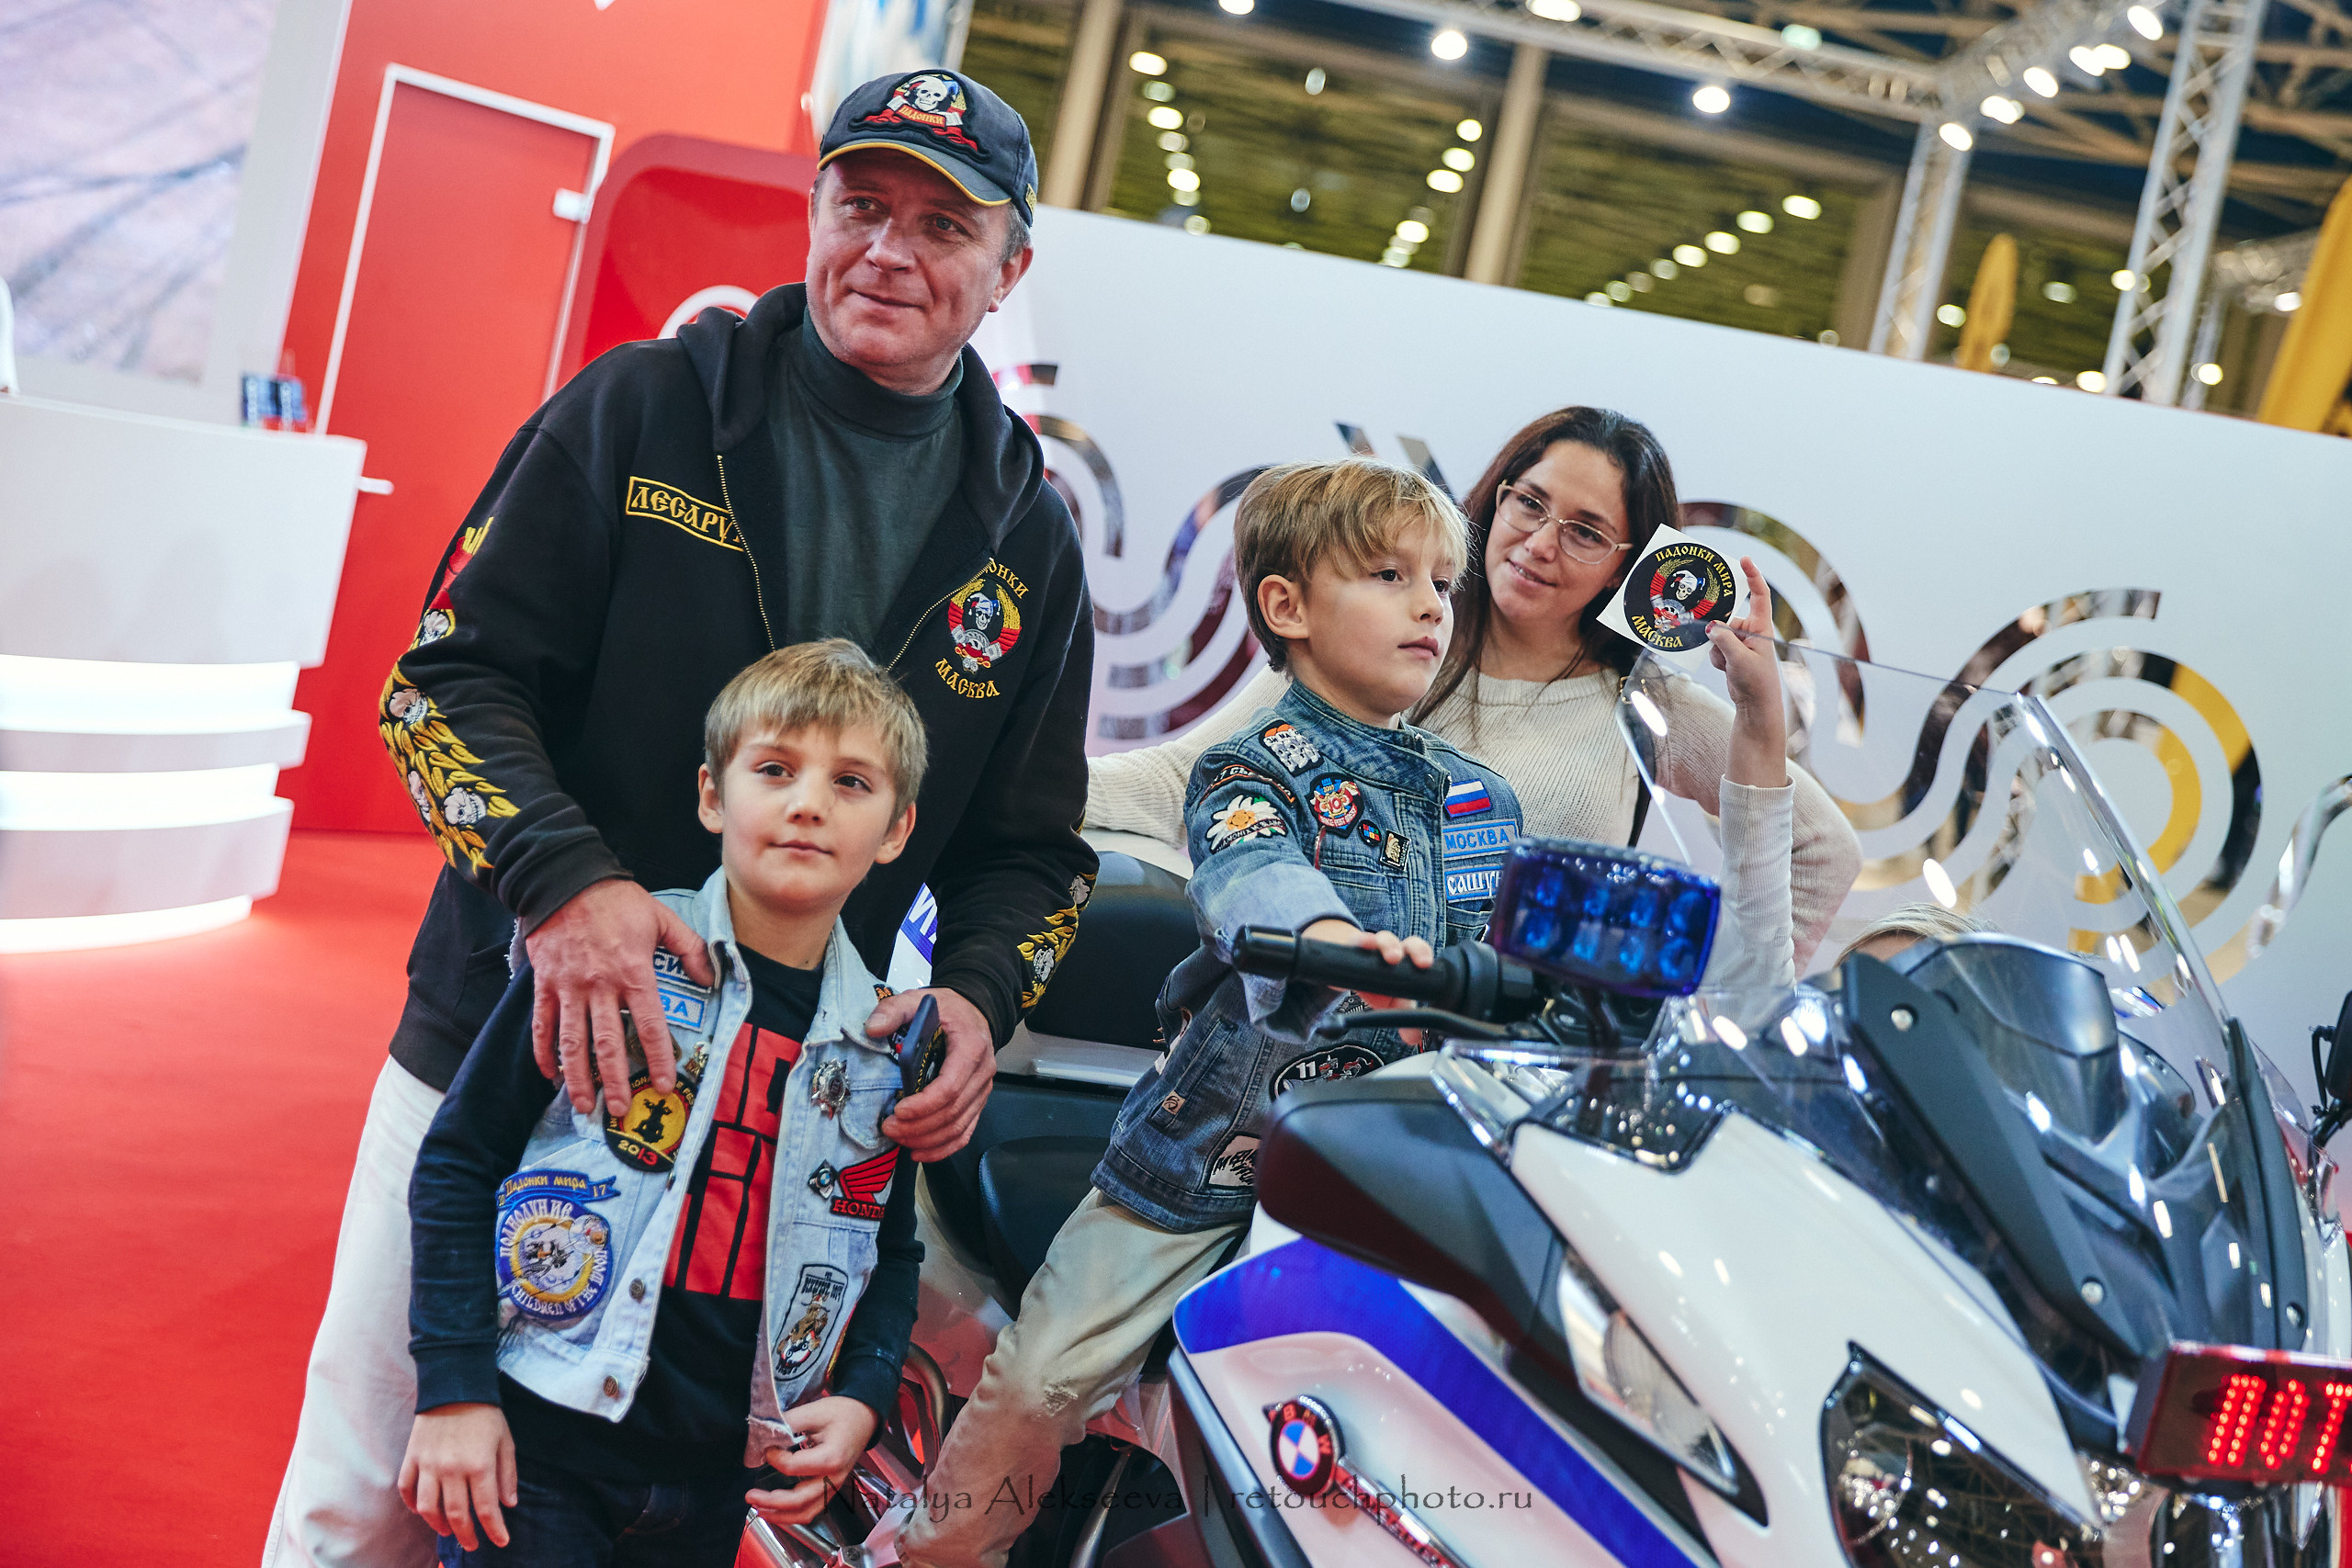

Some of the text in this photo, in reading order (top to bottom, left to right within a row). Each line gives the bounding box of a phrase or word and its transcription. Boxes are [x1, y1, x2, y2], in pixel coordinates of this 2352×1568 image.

[630, 486, 741, 544] ЛЕСАРУ
[1655, 545, 1734, 597] ПАДОНКИ МИРА
[1632, 615, 1683, 649] МАСКВА
[935, 658, 1001, 699] МАСКВА
[1444, 828, 1510, 850] МОСКВА
[1296, 1060, 1316, 1078] 11
[617, 1140, 658, 1166] 2013
[505, 1176, 548, 1197] Падонки
[553, 1175, 586, 1190] мира
[593, 1184, 606, 1197] 17
